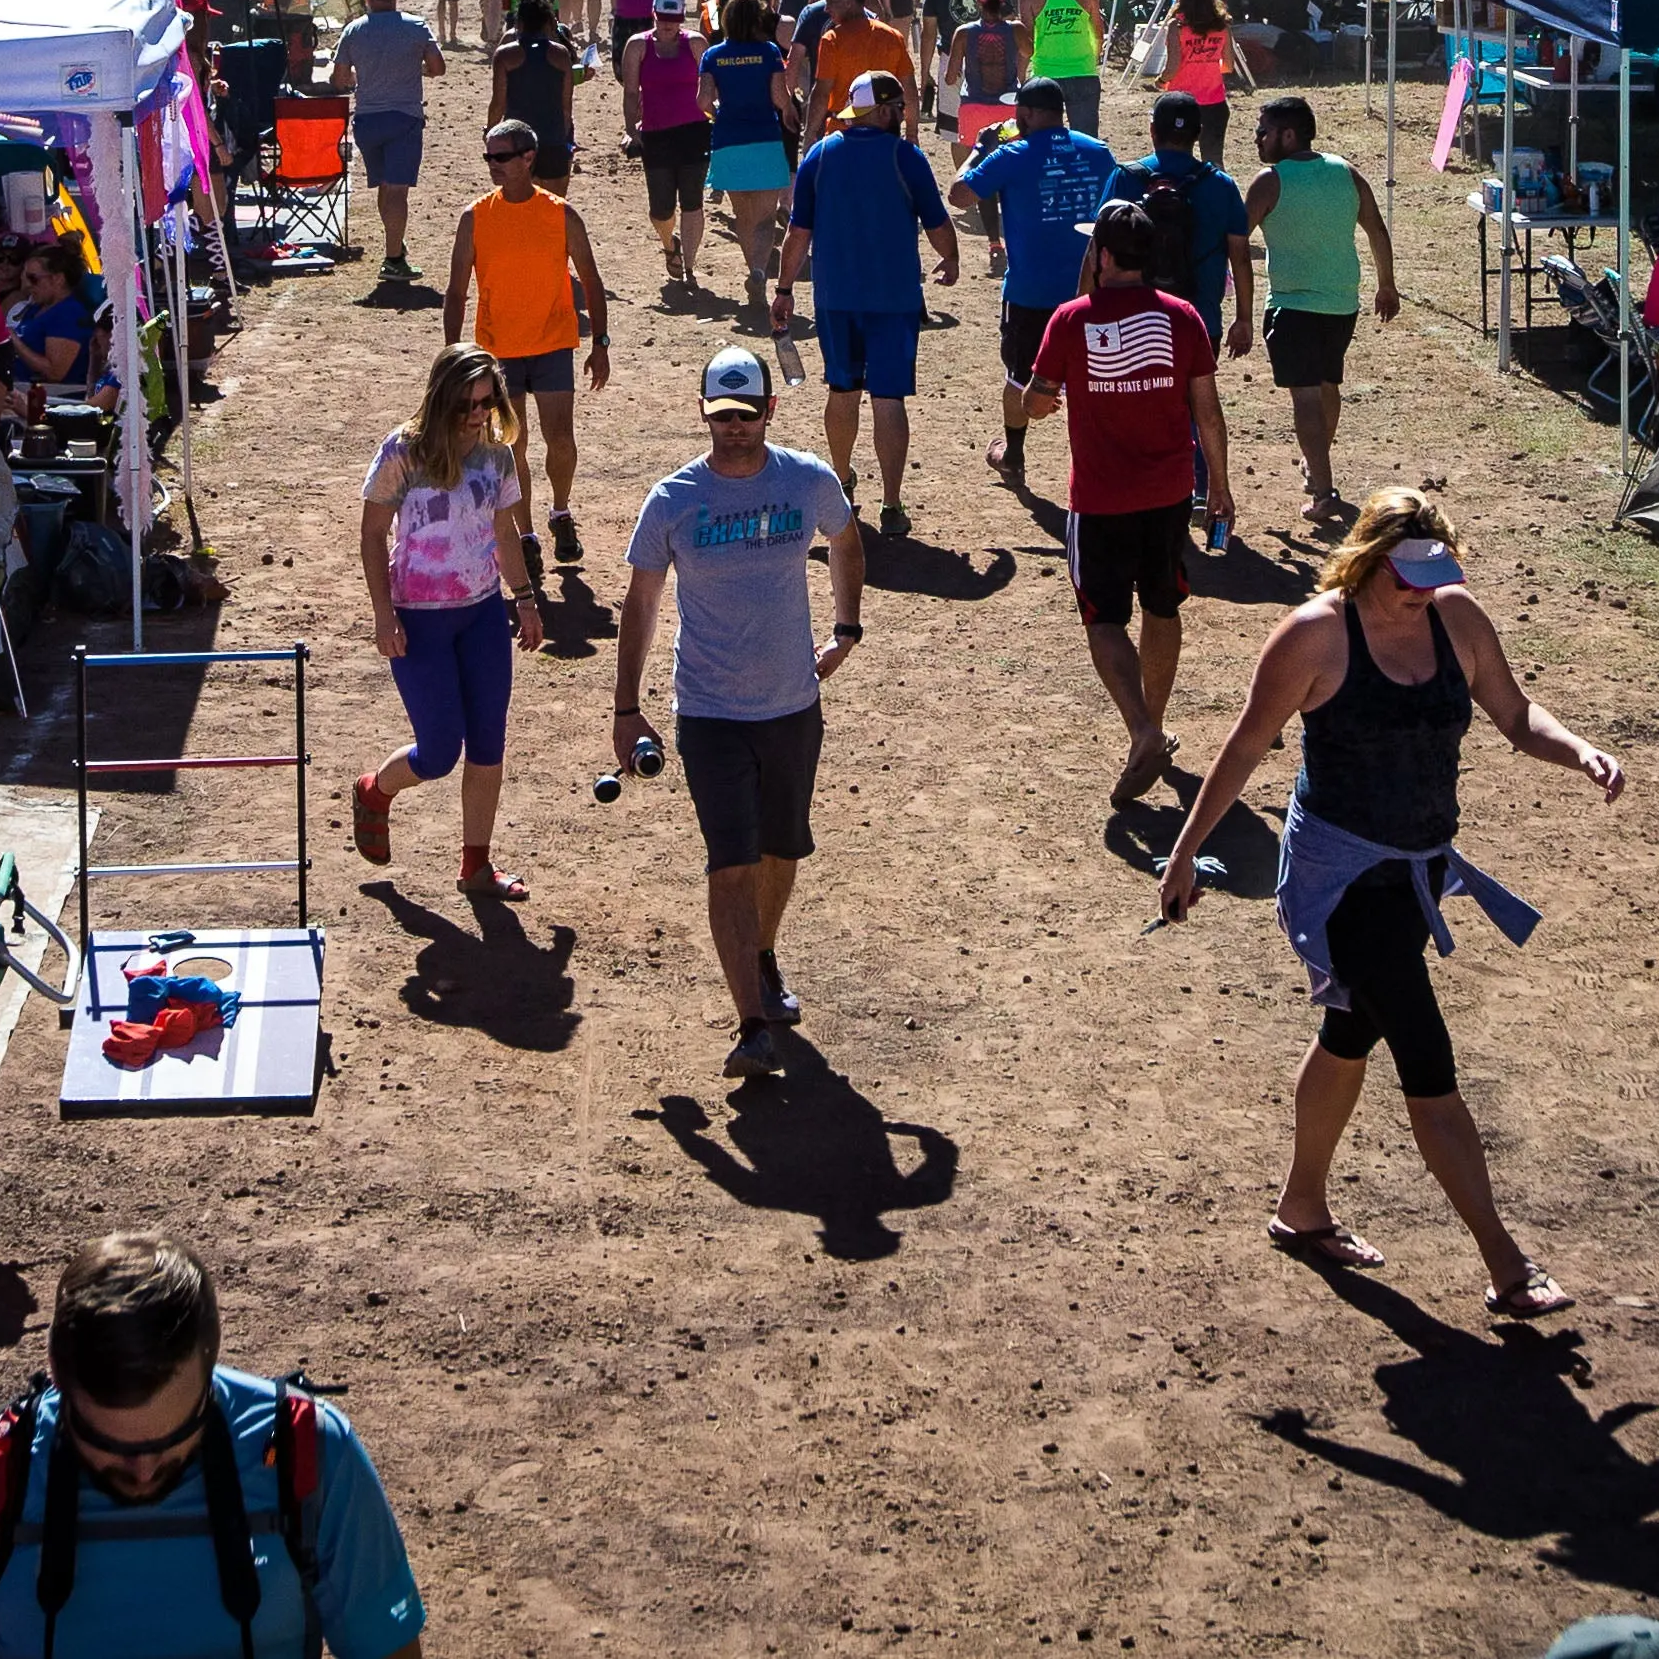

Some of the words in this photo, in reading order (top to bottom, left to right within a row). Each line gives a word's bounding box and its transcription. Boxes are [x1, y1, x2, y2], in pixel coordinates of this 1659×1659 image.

[1088, 380, 1115, 393] DUTCH
[1117, 380, 1141, 393] STATE
[1143, 378, 1152, 391] OF
[1152, 376, 1174, 389] MIND
[745, 538, 764, 551] THE
[766, 530, 804, 548] DREAM
